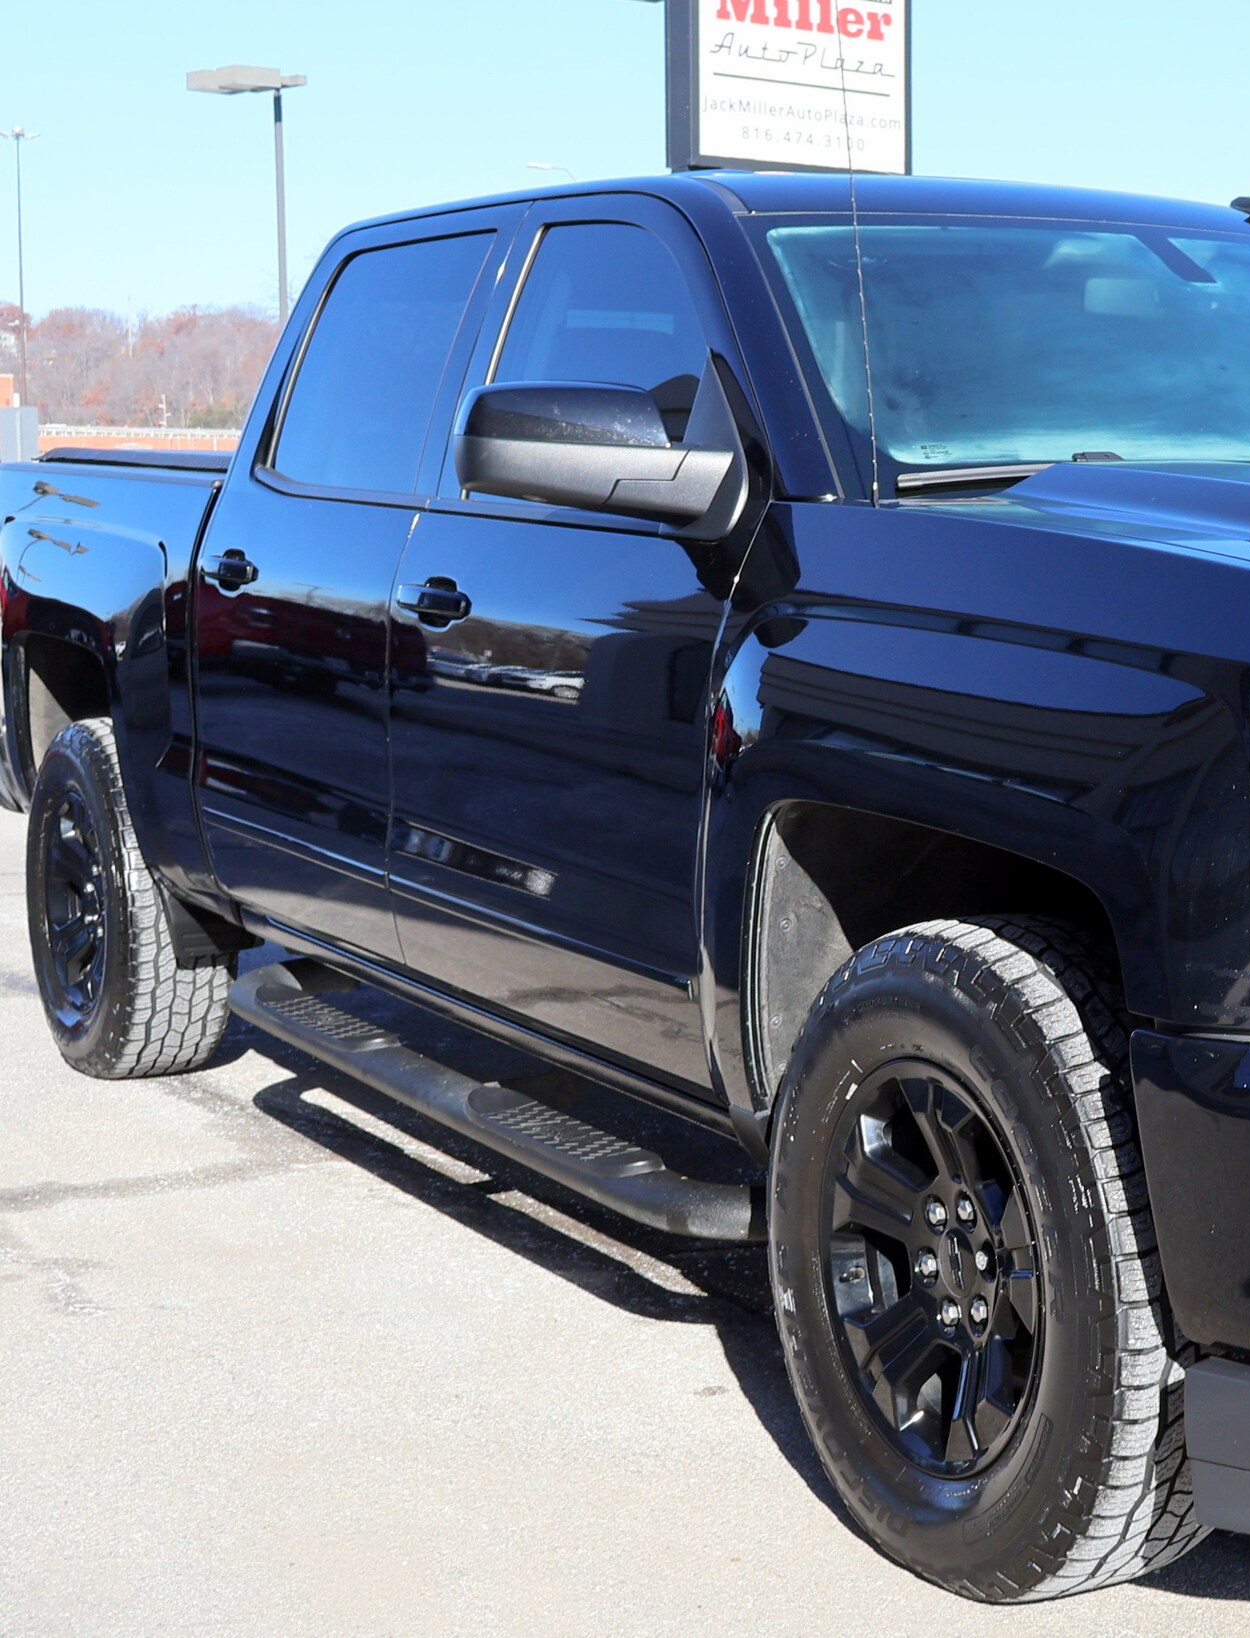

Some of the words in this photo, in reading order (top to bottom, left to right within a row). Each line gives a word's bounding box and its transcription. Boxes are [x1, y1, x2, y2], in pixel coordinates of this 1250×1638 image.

[716, 0, 892, 41] Miller
[703, 96, 901, 130] JackMillerAutoPlaza.com
[741, 126, 865, 151] 816.474.3100
